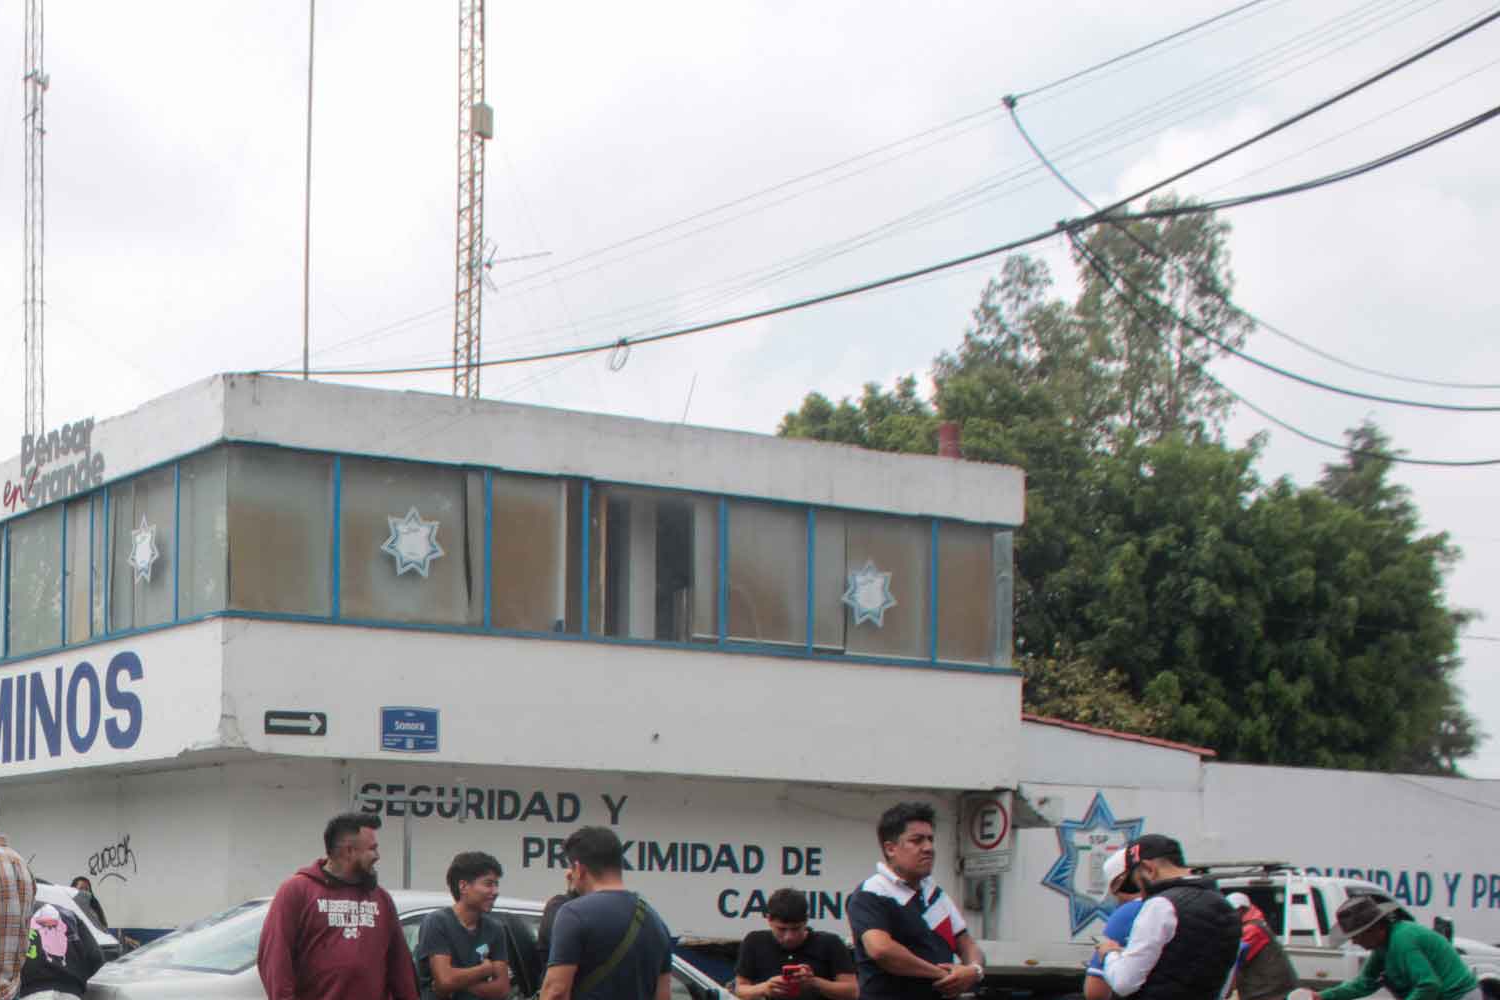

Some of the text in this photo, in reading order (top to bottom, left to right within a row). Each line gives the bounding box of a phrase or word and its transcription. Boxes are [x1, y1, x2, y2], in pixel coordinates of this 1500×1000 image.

[361, 783, 628, 824] SEGURIDAD Y
[980, 810, 997, 839] E
[522, 836, 822, 876] PRXIMIDAD DE
[1443, 871, 1462, 907] Y
